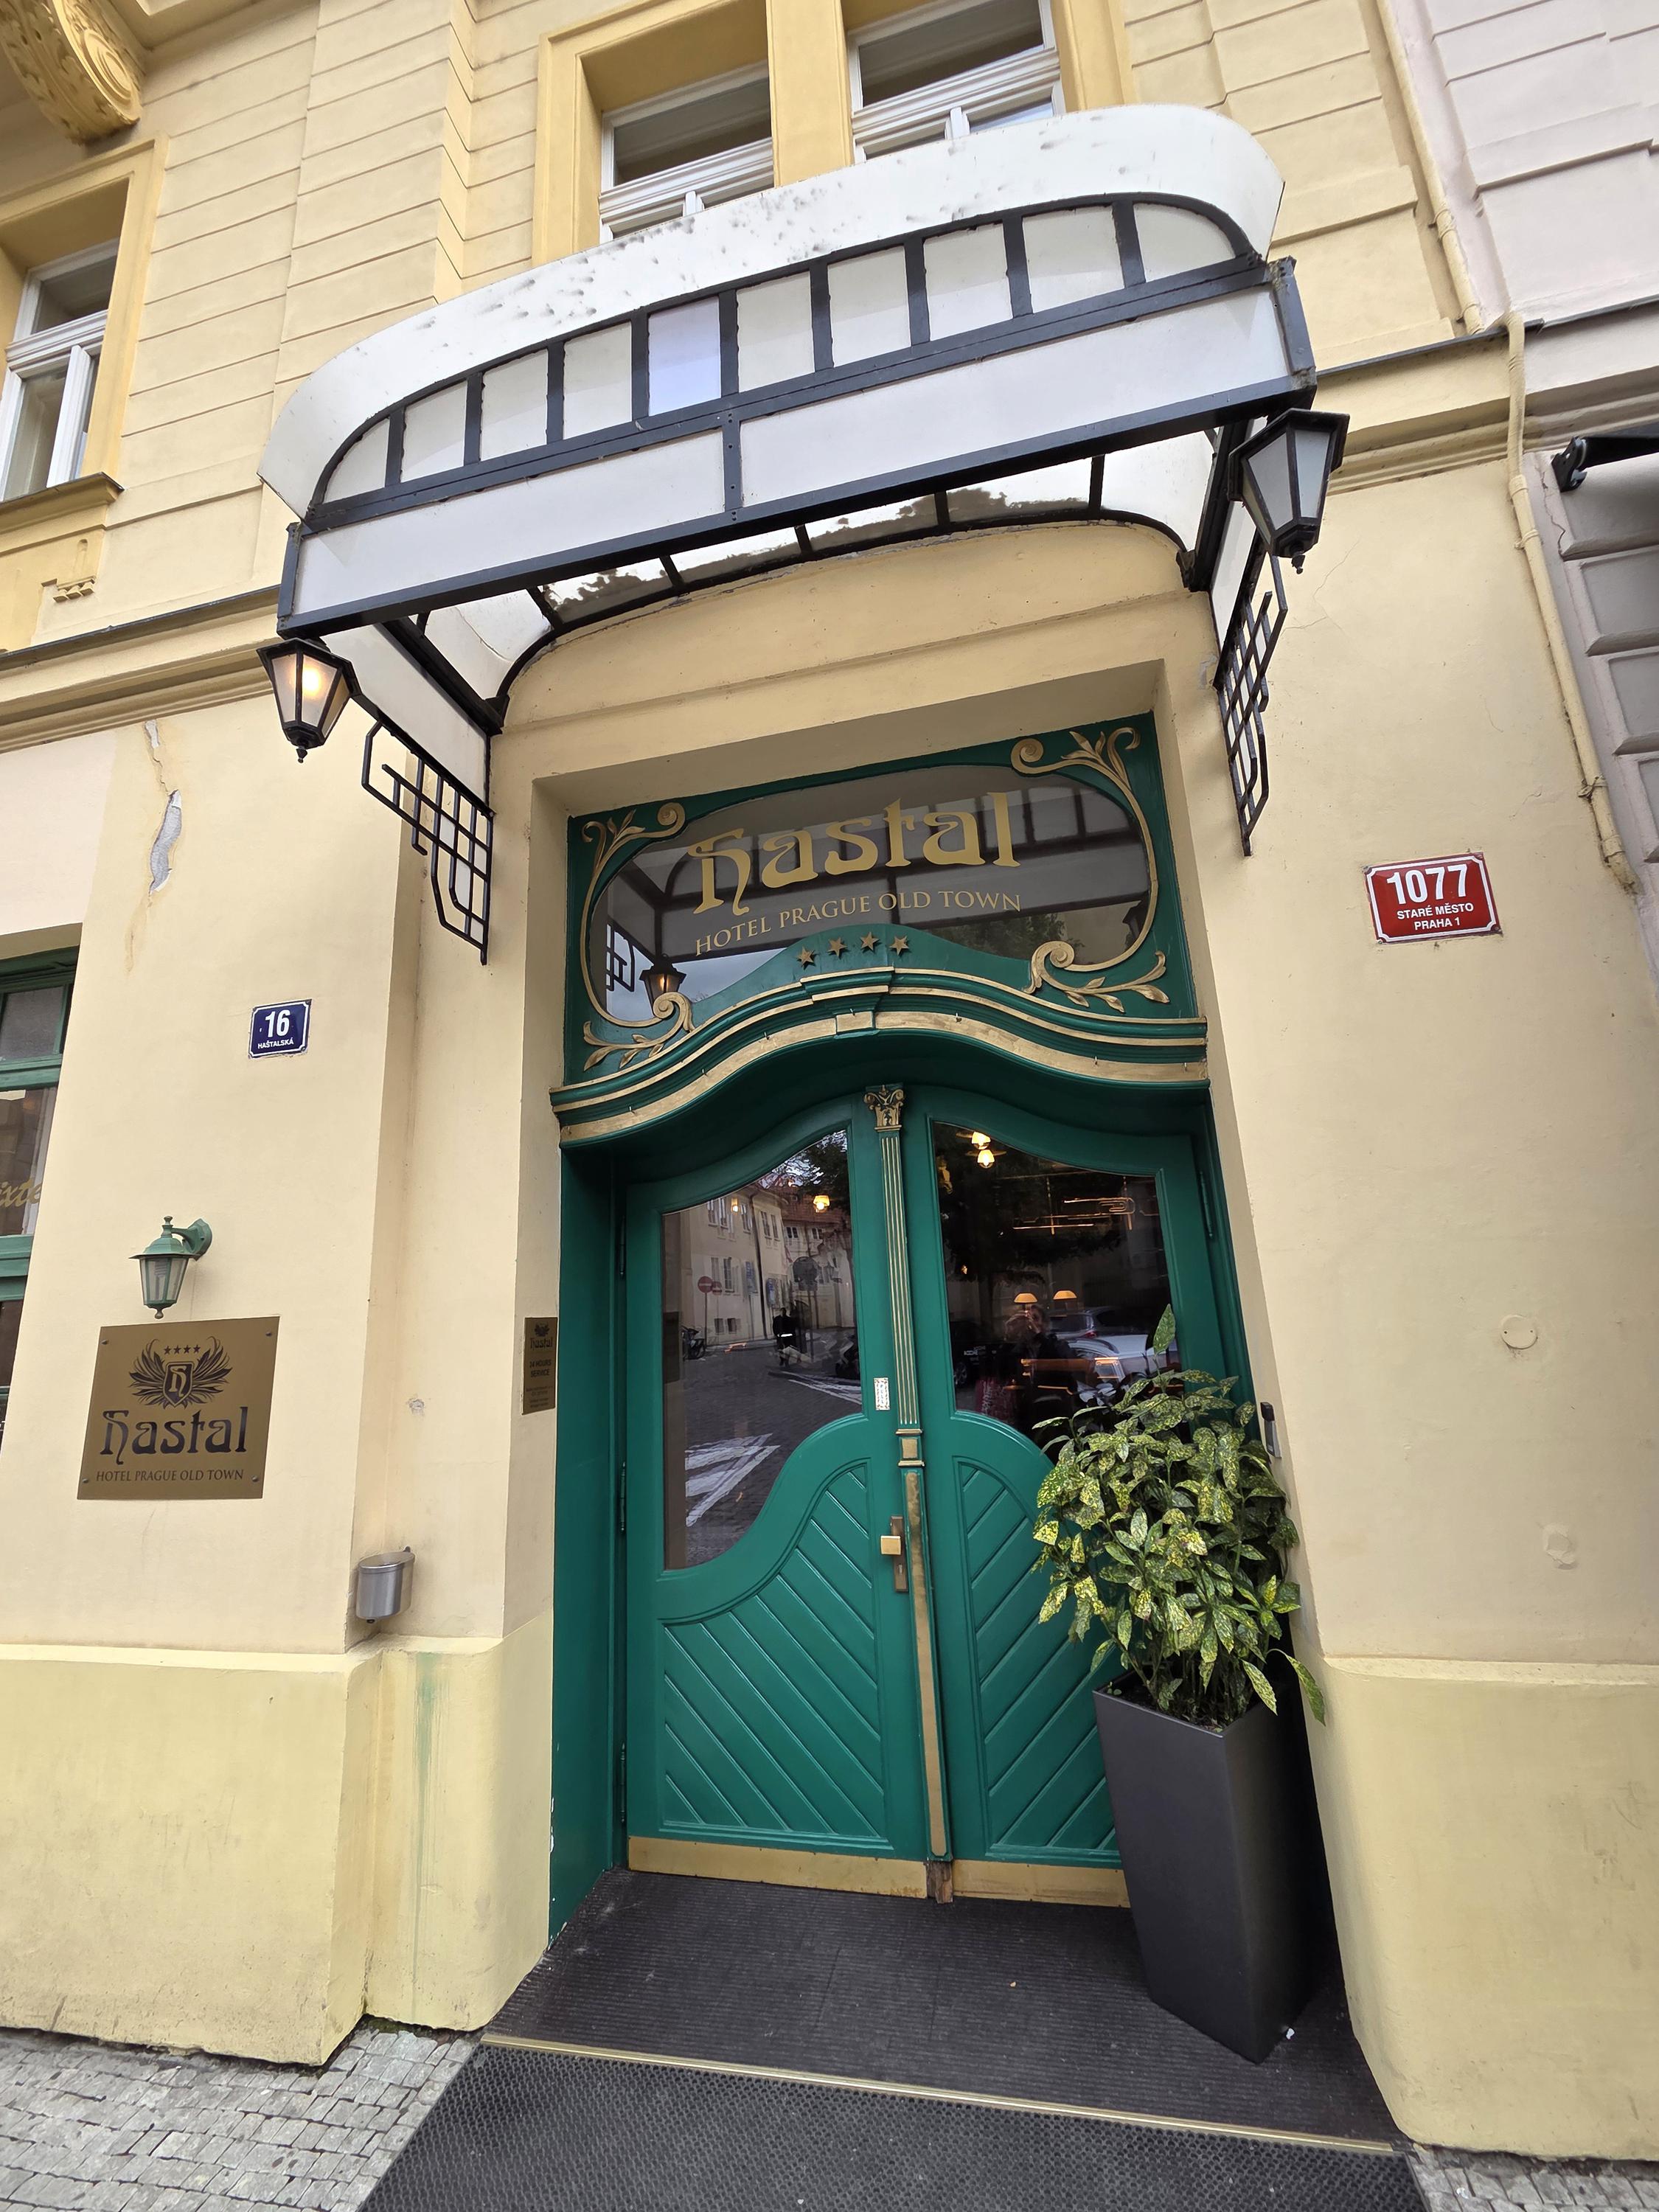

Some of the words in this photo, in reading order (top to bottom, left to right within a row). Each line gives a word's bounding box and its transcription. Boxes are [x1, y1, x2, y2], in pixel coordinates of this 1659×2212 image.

[1386, 863, 1468, 905] 1077
[1397, 905, 1433, 920] STARÉ
[1435, 902, 1474, 916] MĚSTO
[695, 917, 772, 956] HOTEL
[779, 895, 871, 929] PRAGUE
[878, 891, 931, 911] OLD
[939, 890, 1022, 913] TOWN
[1413, 917, 1453, 931] PRAHA
[1454, 917, 1461, 926] 1
[265, 1009, 291, 1038] 16
[257, 1037, 294, 1049] HAŠTALSKÁ
[96, 1470, 132, 1482] HOTEL
[134, 1470, 178, 1481] PRAGUE
[180, 1470, 204, 1481] OLD
[207, 1469, 244, 1481] TOWN
